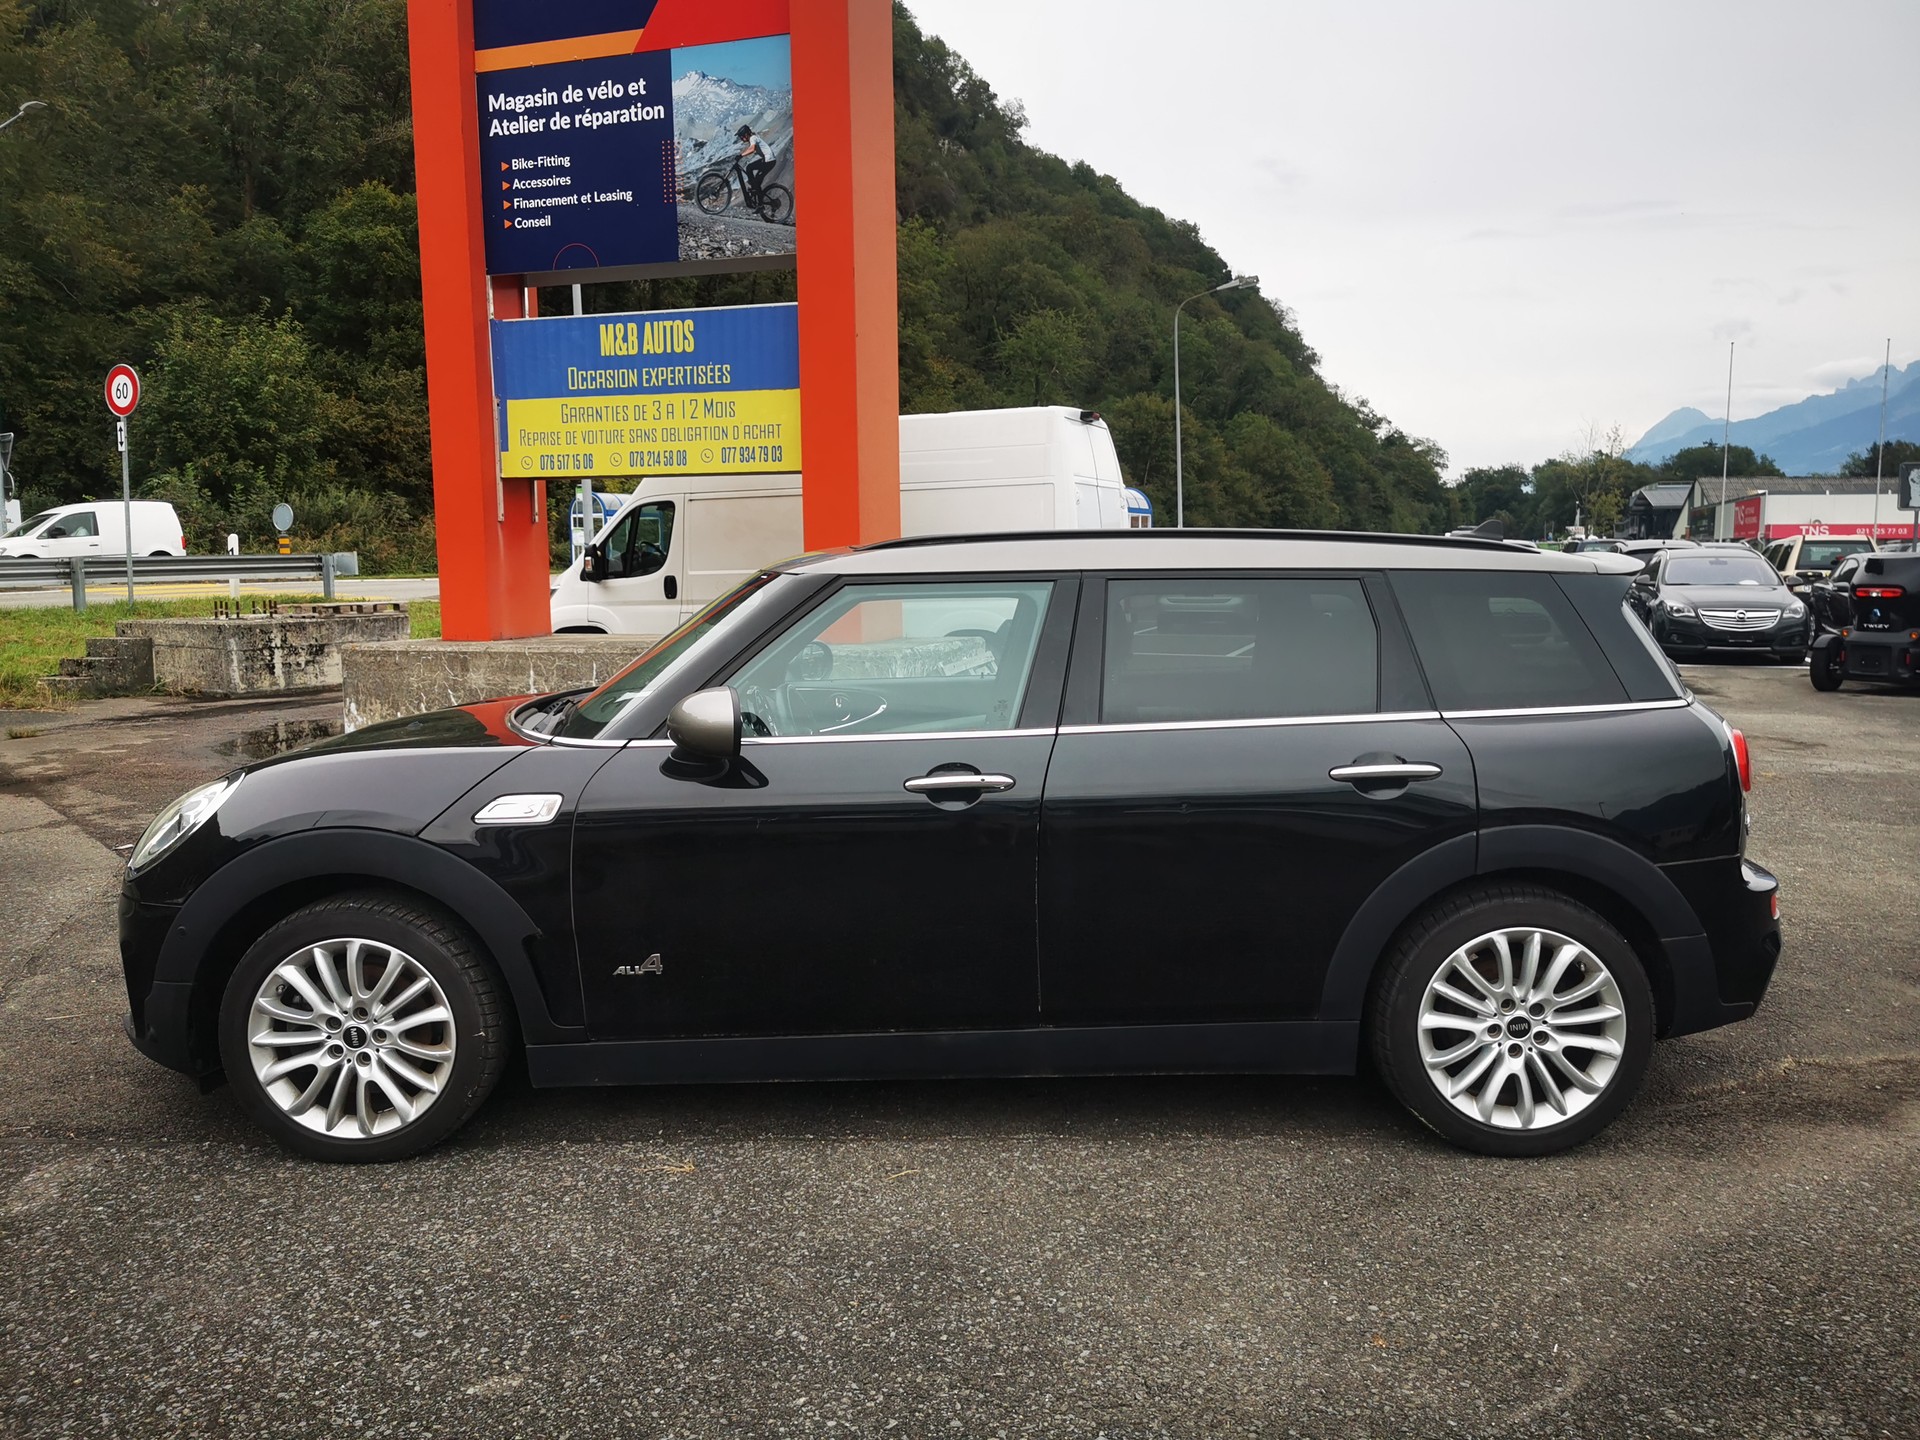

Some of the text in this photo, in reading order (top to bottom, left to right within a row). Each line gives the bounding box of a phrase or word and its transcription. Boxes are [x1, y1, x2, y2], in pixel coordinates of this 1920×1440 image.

[488, 78, 646, 113] Magasin de vélo et
[489, 102, 665, 137] Atelier de réparation
[511, 155, 571, 170] Bike-Fitting
[512, 175, 571, 190] Accessoires
[513, 189, 633, 209] Financement et Leasing
[514, 215, 551, 228] Conseil
[600, 319, 695, 356] M&B AUTOS
[567, 361, 731, 390] OCCASION EXPERTISÉES
[115, 382, 128, 399] 60
[561, 403, 629, 424] GARANTIES
[633, 404, 647, 421] DE
[652, 400, 661, 420] 3
[703, 398, 736, 419] MOIS
[519, 429, 562, 447] REPRISE
[565, 430, 577, 445] DE
[581, 429, 625, 445] VOITURE
[629, 428, 657, 443] SANS
[661, 425, 729, 443] OBLIGATION
[540, 453, 594, 471] 076 517 15 06
[629, 449, 687, 467] 078 214 58 08
[721, 445, 783, 463] 077 934 79 03
[1799, 525, 1830, 536] TNS
[1887, 527, 1896, 535] 77
[612, 953, 663, 975] ALL4
[1509, 1022, 1529, 1032] MINI
[350, 1027, 360, 1046] MINI
